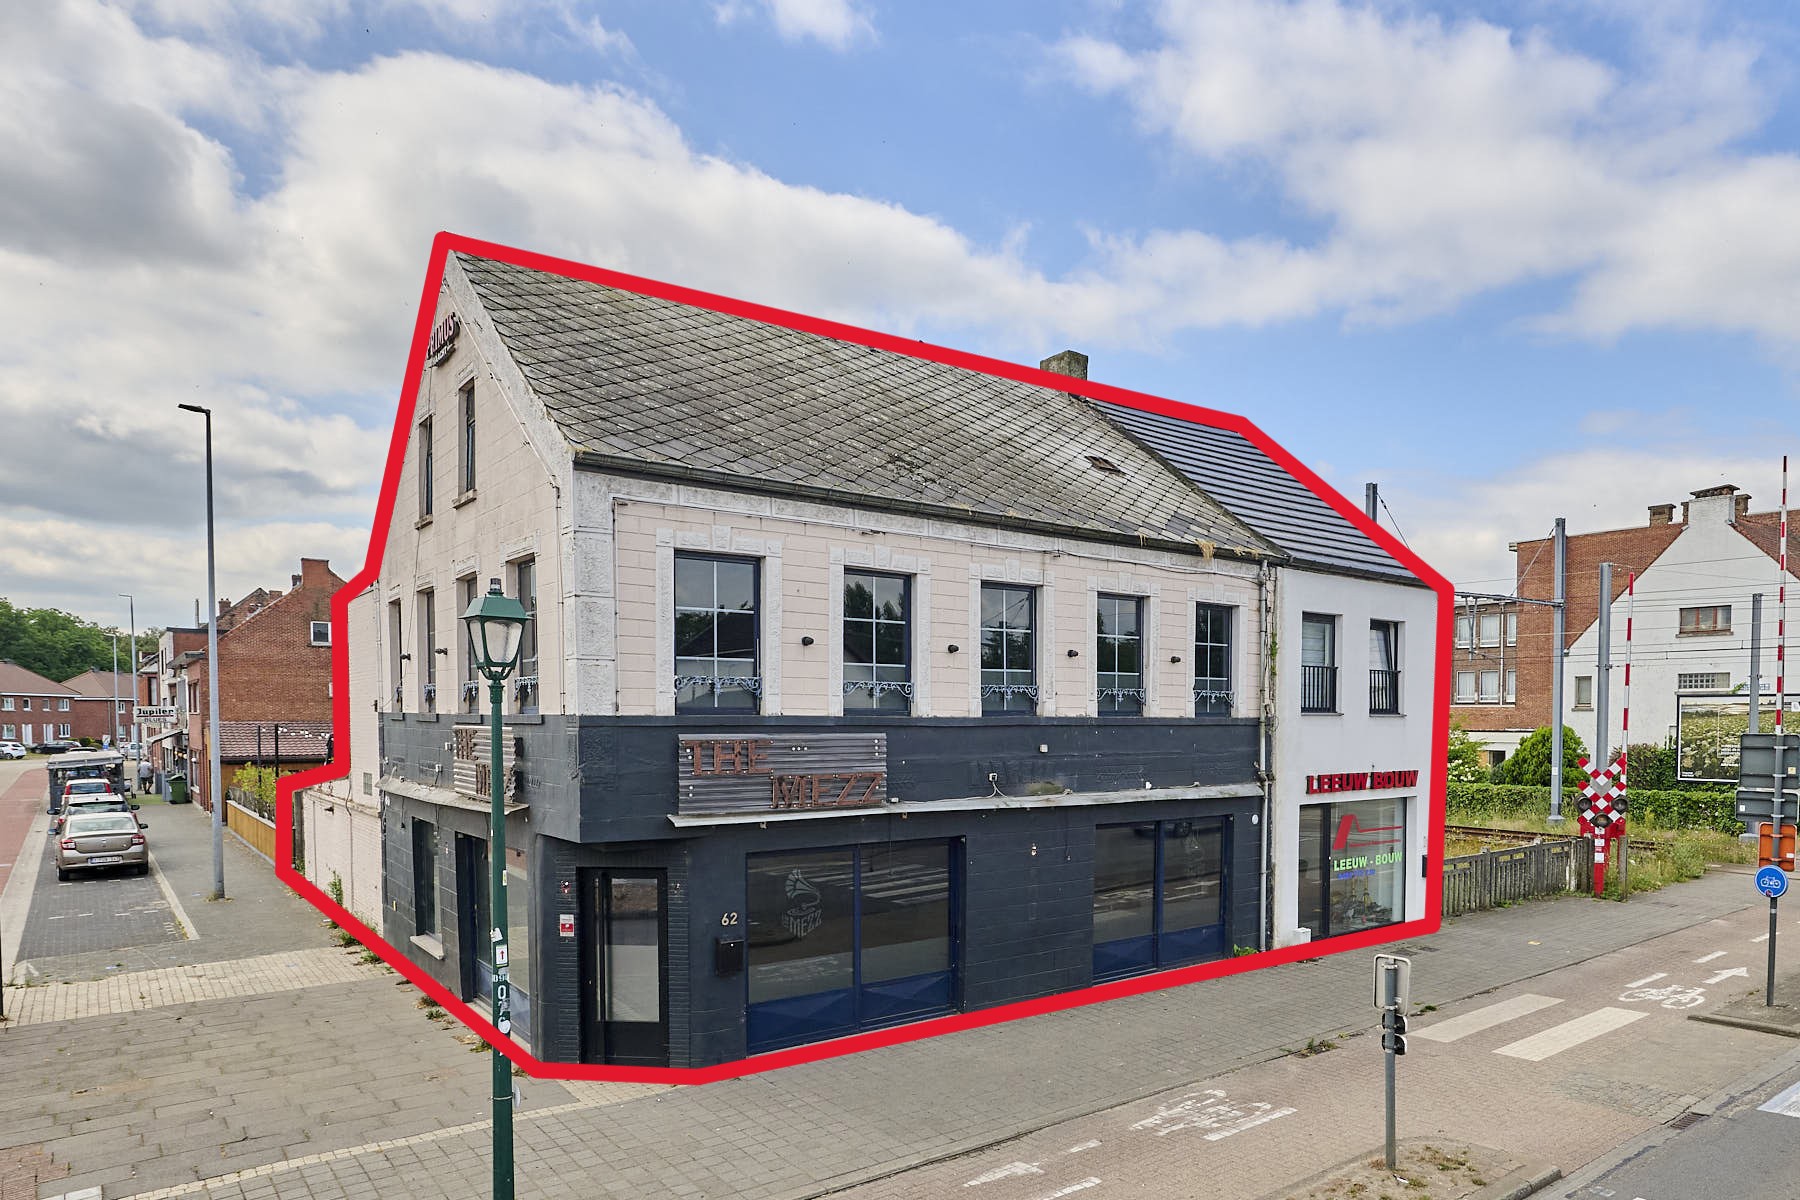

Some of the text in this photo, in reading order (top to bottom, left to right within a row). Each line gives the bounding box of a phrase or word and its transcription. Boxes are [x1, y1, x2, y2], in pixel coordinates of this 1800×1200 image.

[137, 707, 174, 716] Jupiler
[680, 739, 773, 776] THE
[770, 772, 885, 809] MEZZ
[1306, 770, 1419, 794] LEEUW BOUW
[1333, 856, 1367, 872] LEEUW
[1375, 851, 1403, 866] BOUW
[721, 911, 738, 926] 62
